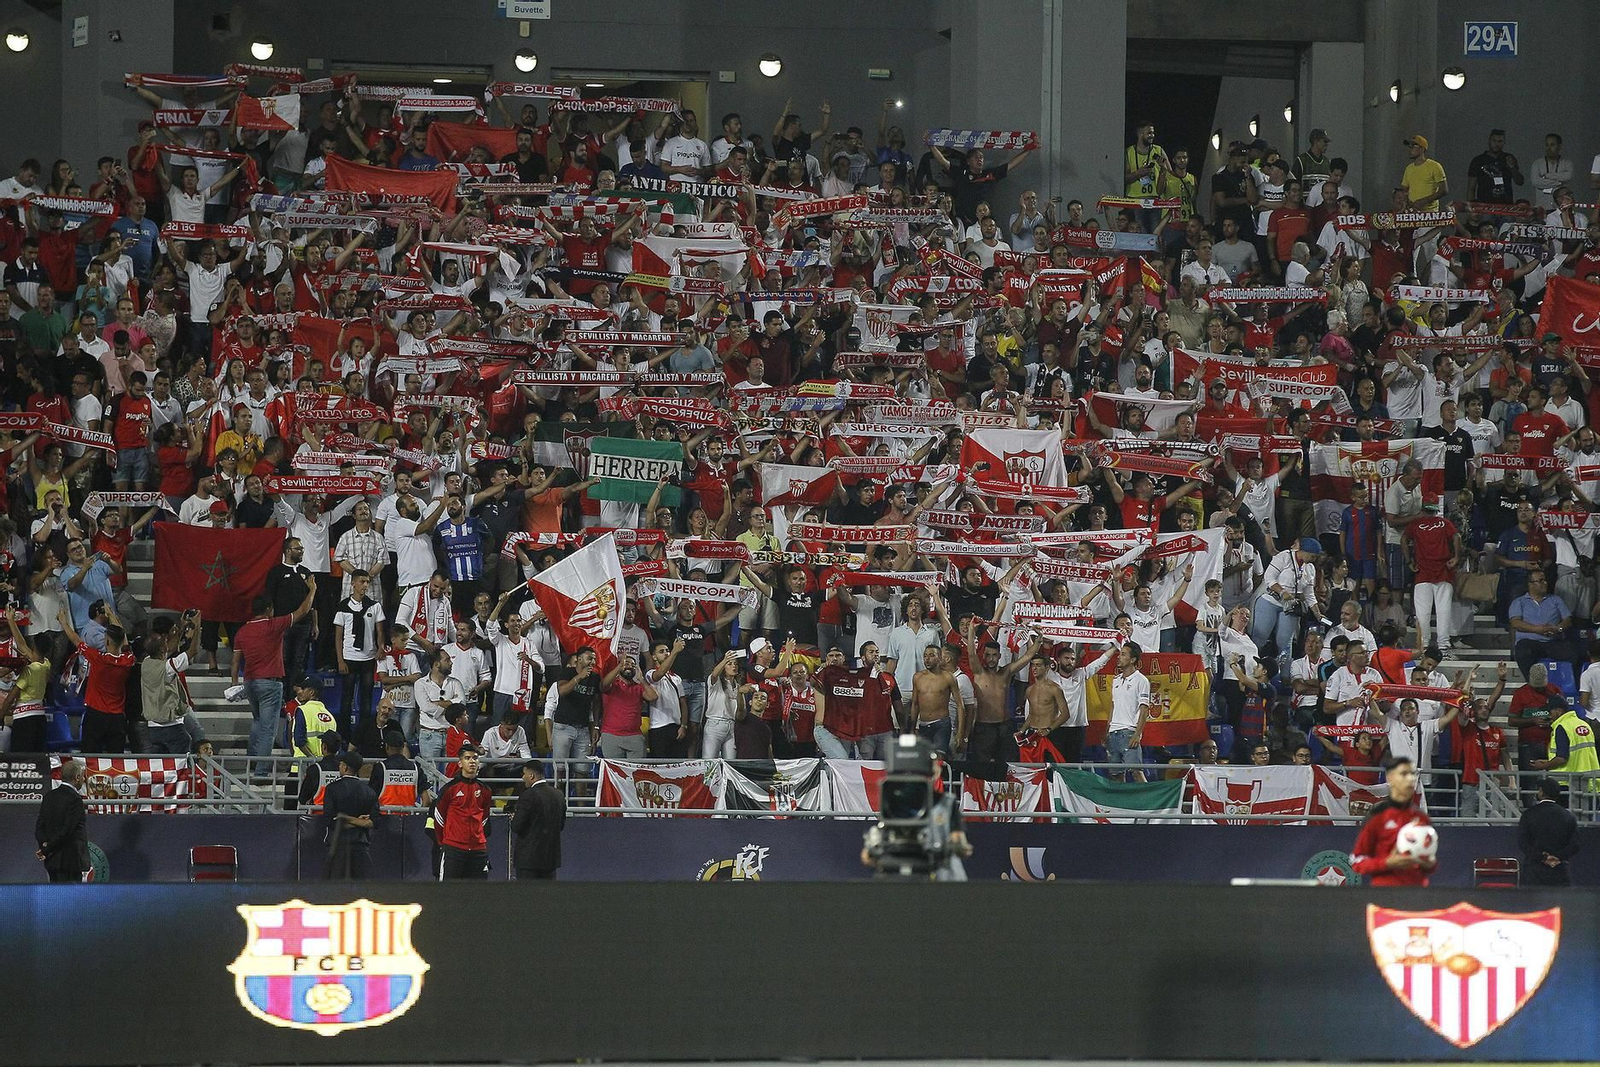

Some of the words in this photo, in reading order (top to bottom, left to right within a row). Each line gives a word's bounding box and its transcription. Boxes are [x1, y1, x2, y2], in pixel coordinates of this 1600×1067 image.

[515, 6, 544, 14] Buvette
[1468, 26, 1514, 51] 29A
[514, 86, 577, 97] POULSEN
[156, 112, 195, 124] FINAL
[631, 177, 666, 192] ANTI
[681, 185, 737, 198] BETICO
[1142, 185, 1153, 194] 60
[792, 196, 841, 216] SEVILLA
[288, 215, 357, 226] SUPERCOPA
[1337, 214, 1365, 225] DOS
[1396, 212, 1454, 220] HERMANAS
[163, 221, 180, 231] RE
[181, 223, 196, 232] DEL
[1068, 229, 1092, 238] Sevilla
[1459, 238, 1488, 249] SEMI
[1504, 243, 1536, 256] FINAL
[1010, 277, 1028, 288] PEÑA
[578, 332, 620, 341] SEVILLISTA
[622, 333, 628, 341] Y
[631, 333, 672, 342] MACARENO
[888, 354, 922, 365] NORT
[527, 372, 567, 381] SEVILLISTA
[570, 373, 577, 381] Y
[579, 373, 620, 382] MACARENO
[640, 373, 680, 382] SEVILLISTA
[682, 374, 688, 382] Y
[690, 373, 723, 382] MACARE
[1269, 382, 1337, 396] SUPERCOPA
[881, 406, 913, 417] VAMOS
[933, 407, 957, 418] COPA
[964, 416, 1010, 426] ETICOS
[850, 426, 926, 436] SUPERCOPA
[1483, 457, 1506, 466] FINAL
[1506, 457, 1525, 466] COPA
[1538, 458, 1554, 468] DEL
[593, 455, 680, 482] HERRERA
[281, 477, 363, 487] SevillaFútbolClub
[98, 492, 164, 502] SUPERCOPA
[928, 512, 969, 525] BIRIS
[985, 516, 1032, 530] NORTE
[1542, 513, 1579, 527] FINAL
[1035, 562, 1086, 577] SEVILLA
[660, 583, 735, 599] SUPERCOPA
[1067, 629, 1093, 637] NUESTRA
[11, 762, 36, 770] nos
[11, 769, 43, 778] vida.
[0, 782, 43, 790] eterno
